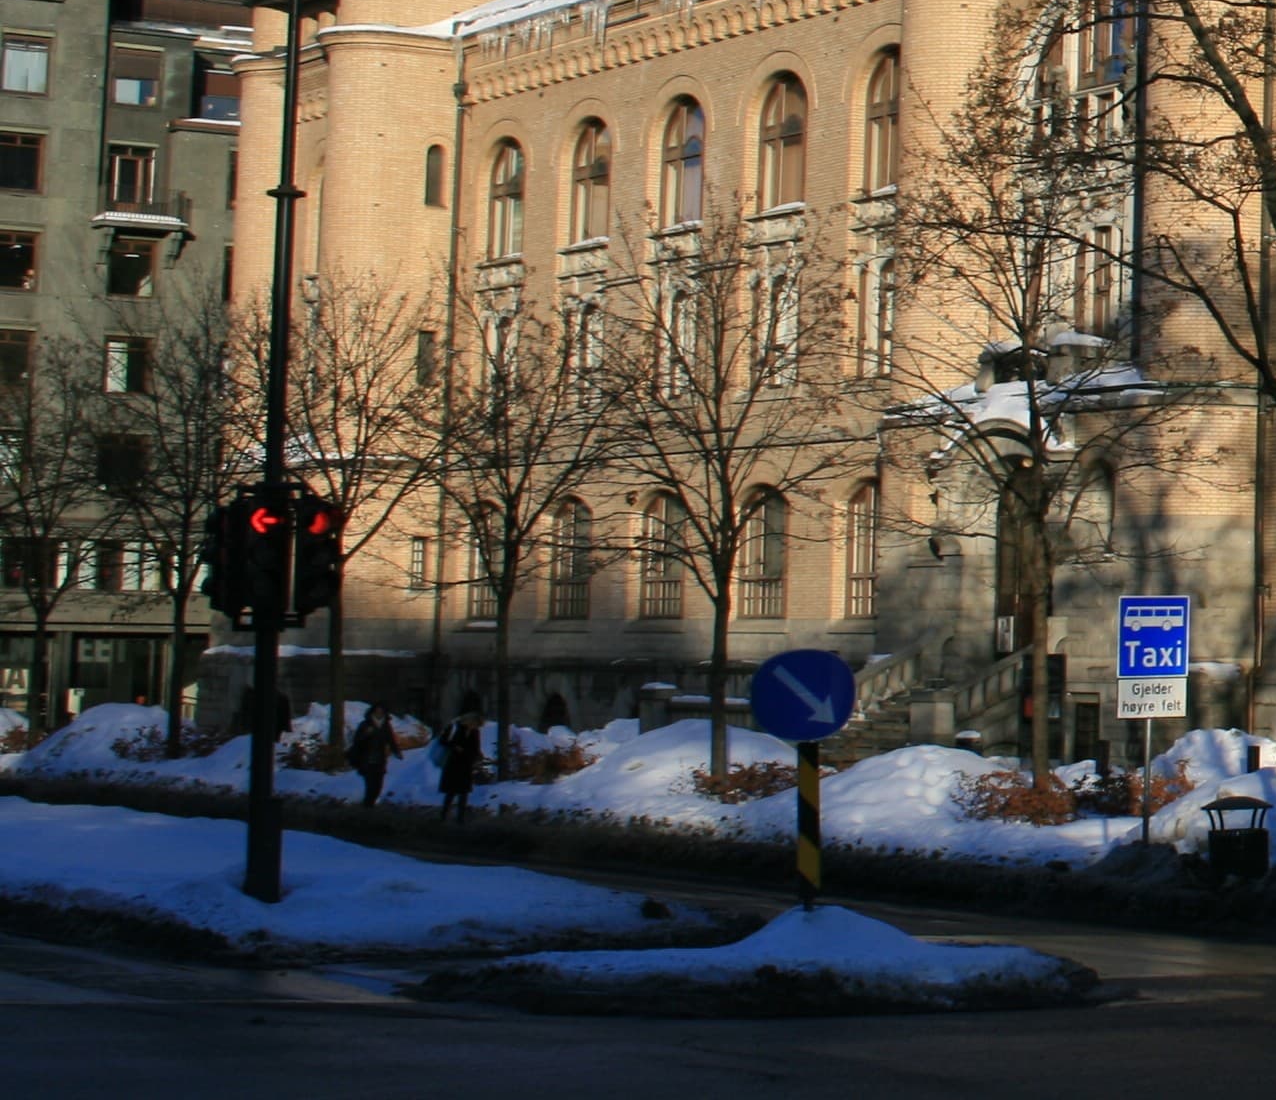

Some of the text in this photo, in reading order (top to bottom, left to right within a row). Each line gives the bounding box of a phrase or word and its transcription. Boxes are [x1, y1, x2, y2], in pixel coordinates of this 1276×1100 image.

[1124, 640, 1182, 668] Taxi
[1131, 683, 1172, 698] Gjelder
[1122, 700, 1182, 715] høyre felt
